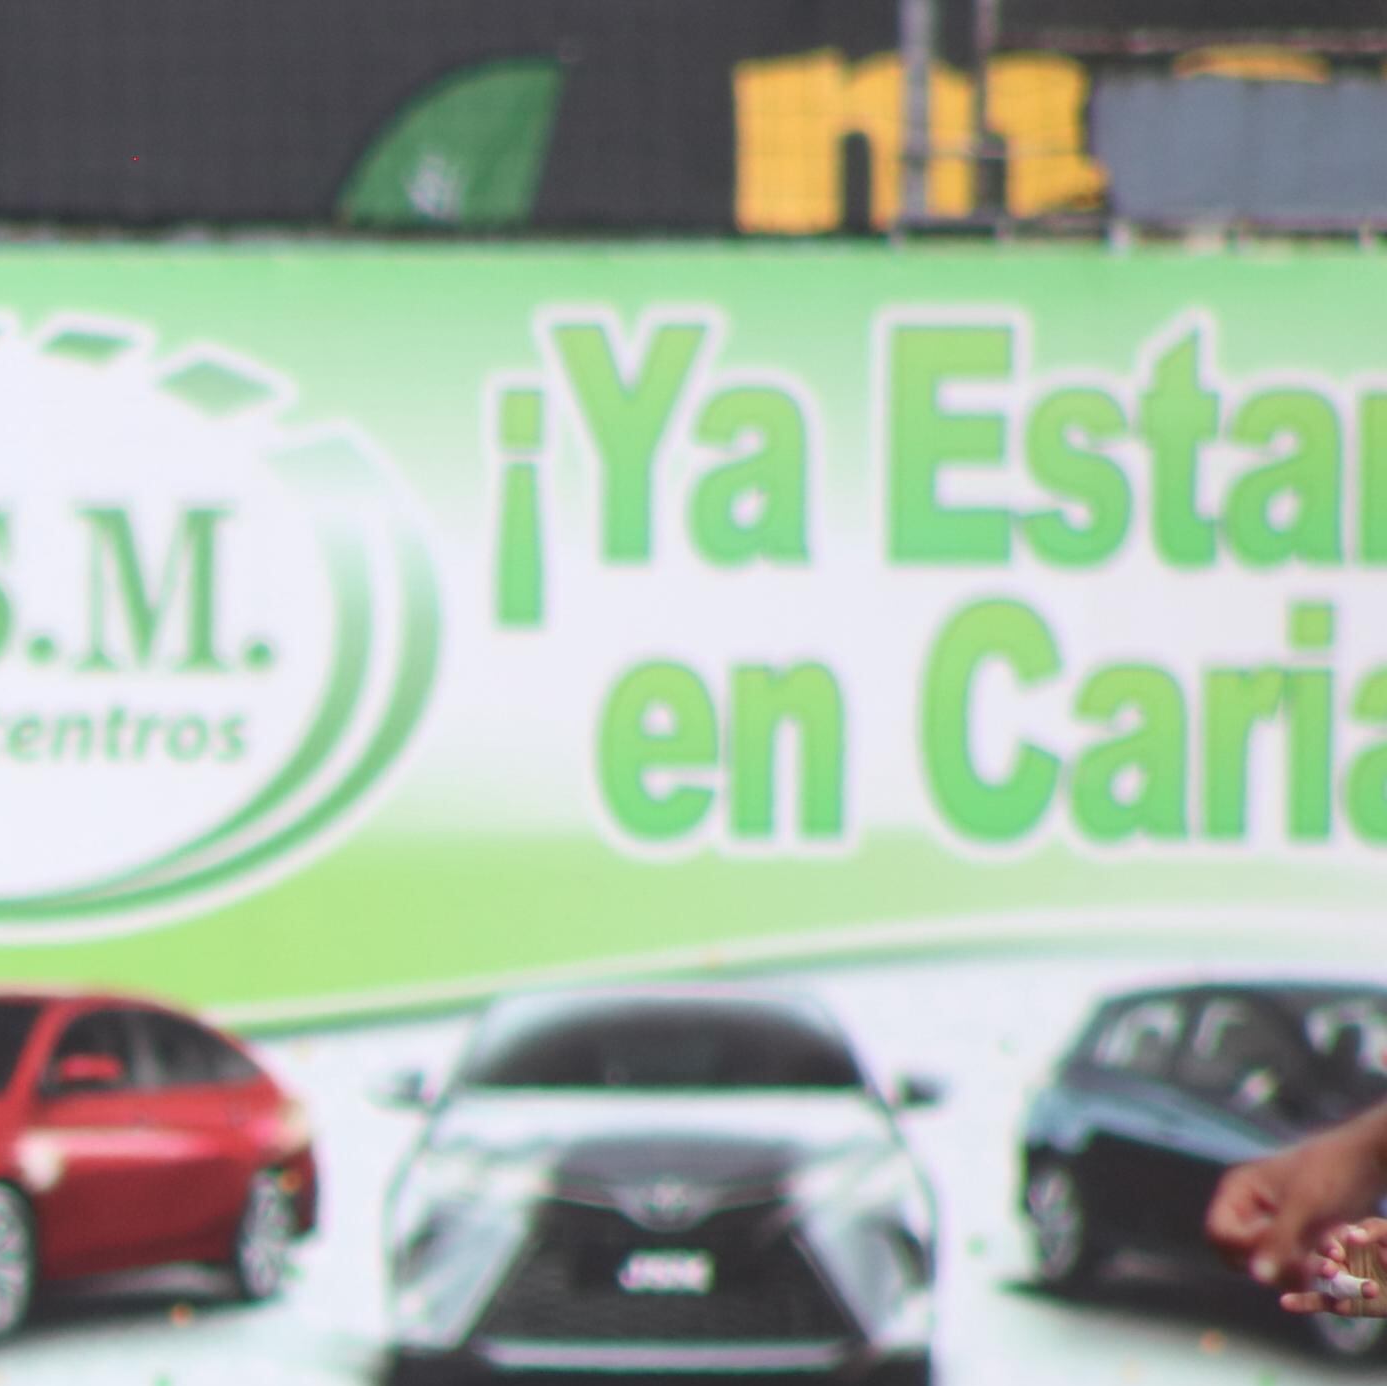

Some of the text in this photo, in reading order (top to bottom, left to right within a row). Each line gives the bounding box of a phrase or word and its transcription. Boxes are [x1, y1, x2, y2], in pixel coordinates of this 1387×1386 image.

[491, 318, 1387, 634] ¡Ya Esta
[595, 656, 849, 845] en
